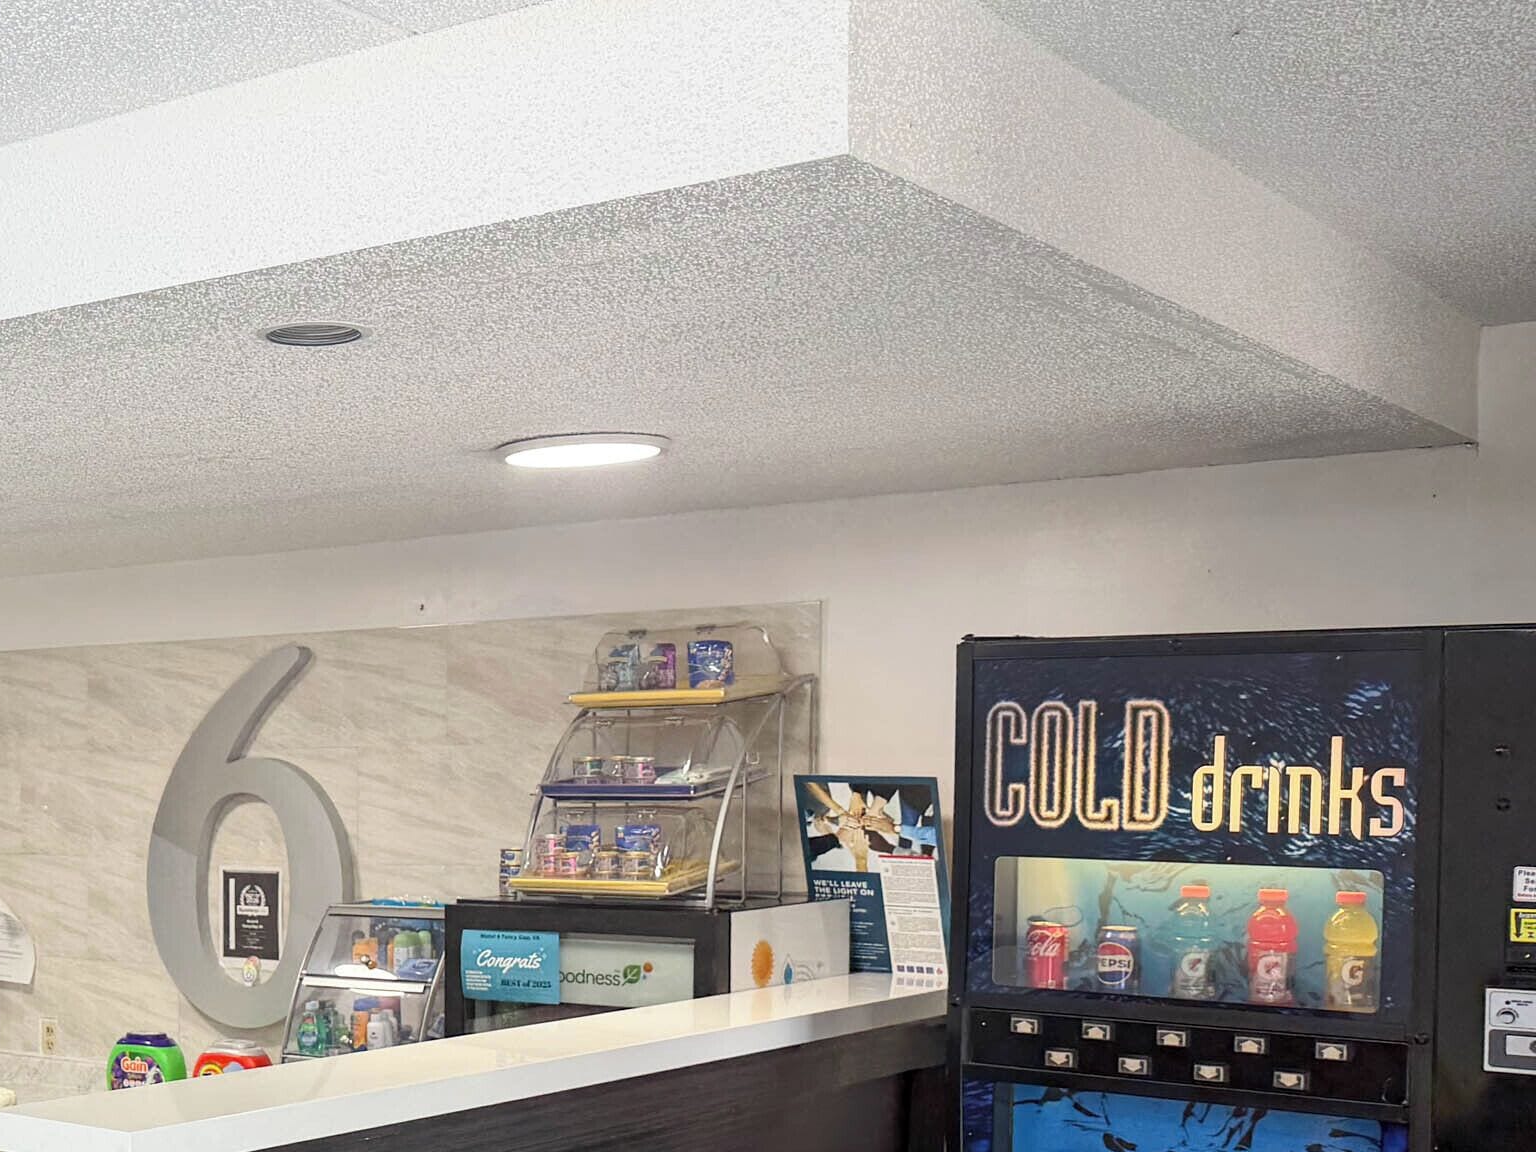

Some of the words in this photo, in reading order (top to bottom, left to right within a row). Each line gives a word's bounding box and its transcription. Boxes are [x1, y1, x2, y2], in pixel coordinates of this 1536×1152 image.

[984, 699, 1173, 831] COLD
[1190, 734, 1406, 841] drinks
[147, 642, 354, 1029] 6
[476, 949, 542, 974] Congrats
[1098, 958, 1130, 969] EPSI
[1341, 958, 1364, 986] G
[501, 979, 520, 988] BEST
[560, 970, 620, 986] oodness
[122, 1056, 148, 1073] Gain
